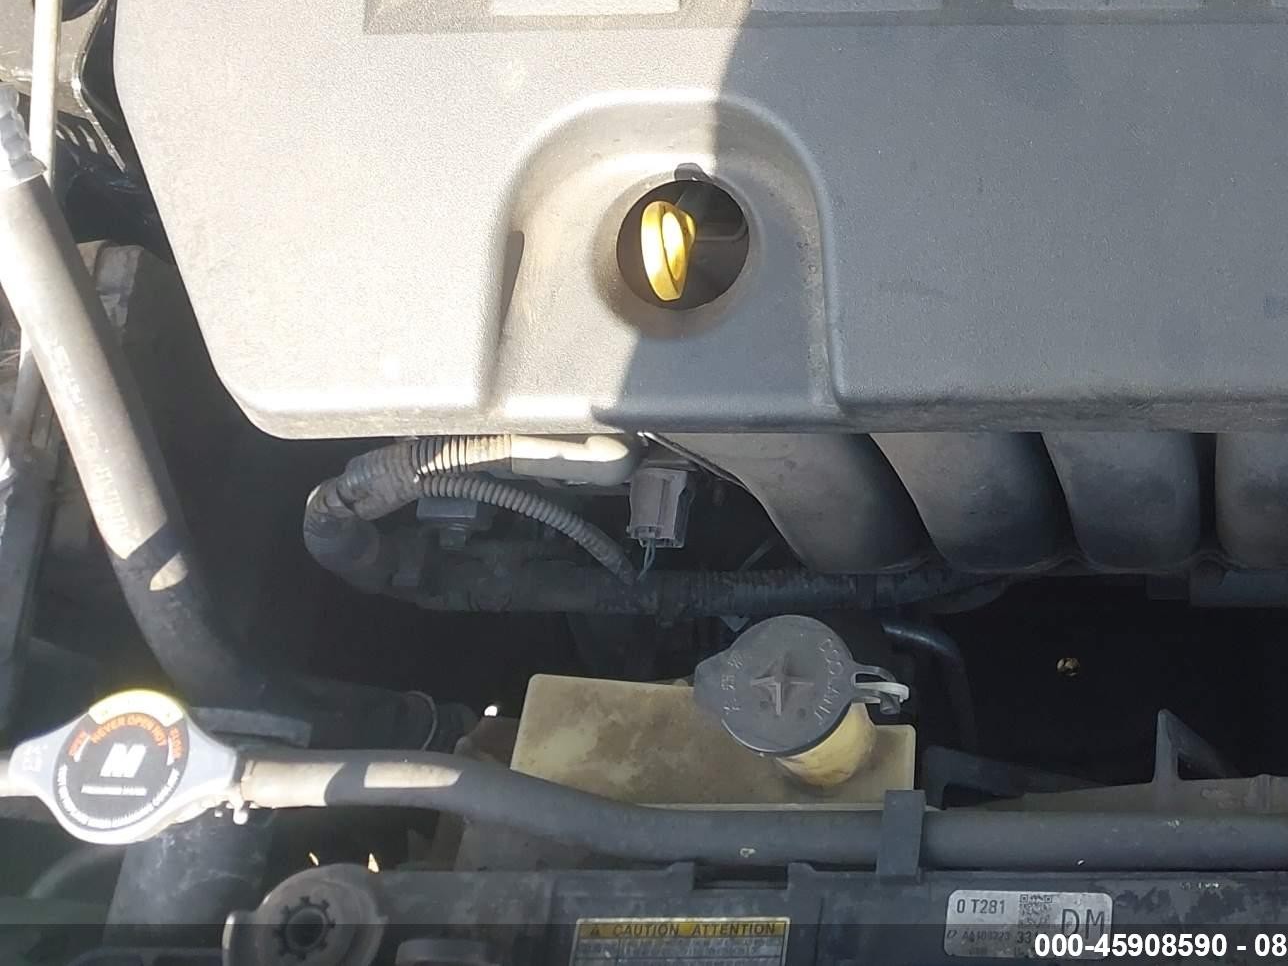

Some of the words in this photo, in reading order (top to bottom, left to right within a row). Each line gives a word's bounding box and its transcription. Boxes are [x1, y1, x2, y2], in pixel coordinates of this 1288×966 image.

[971, 899, 1006, 915] T281
[613, 923, 679, 936] CAUTION
[692, 922, 776, 936] ATTENTION
[1061, 908, 1105, 940] DM
